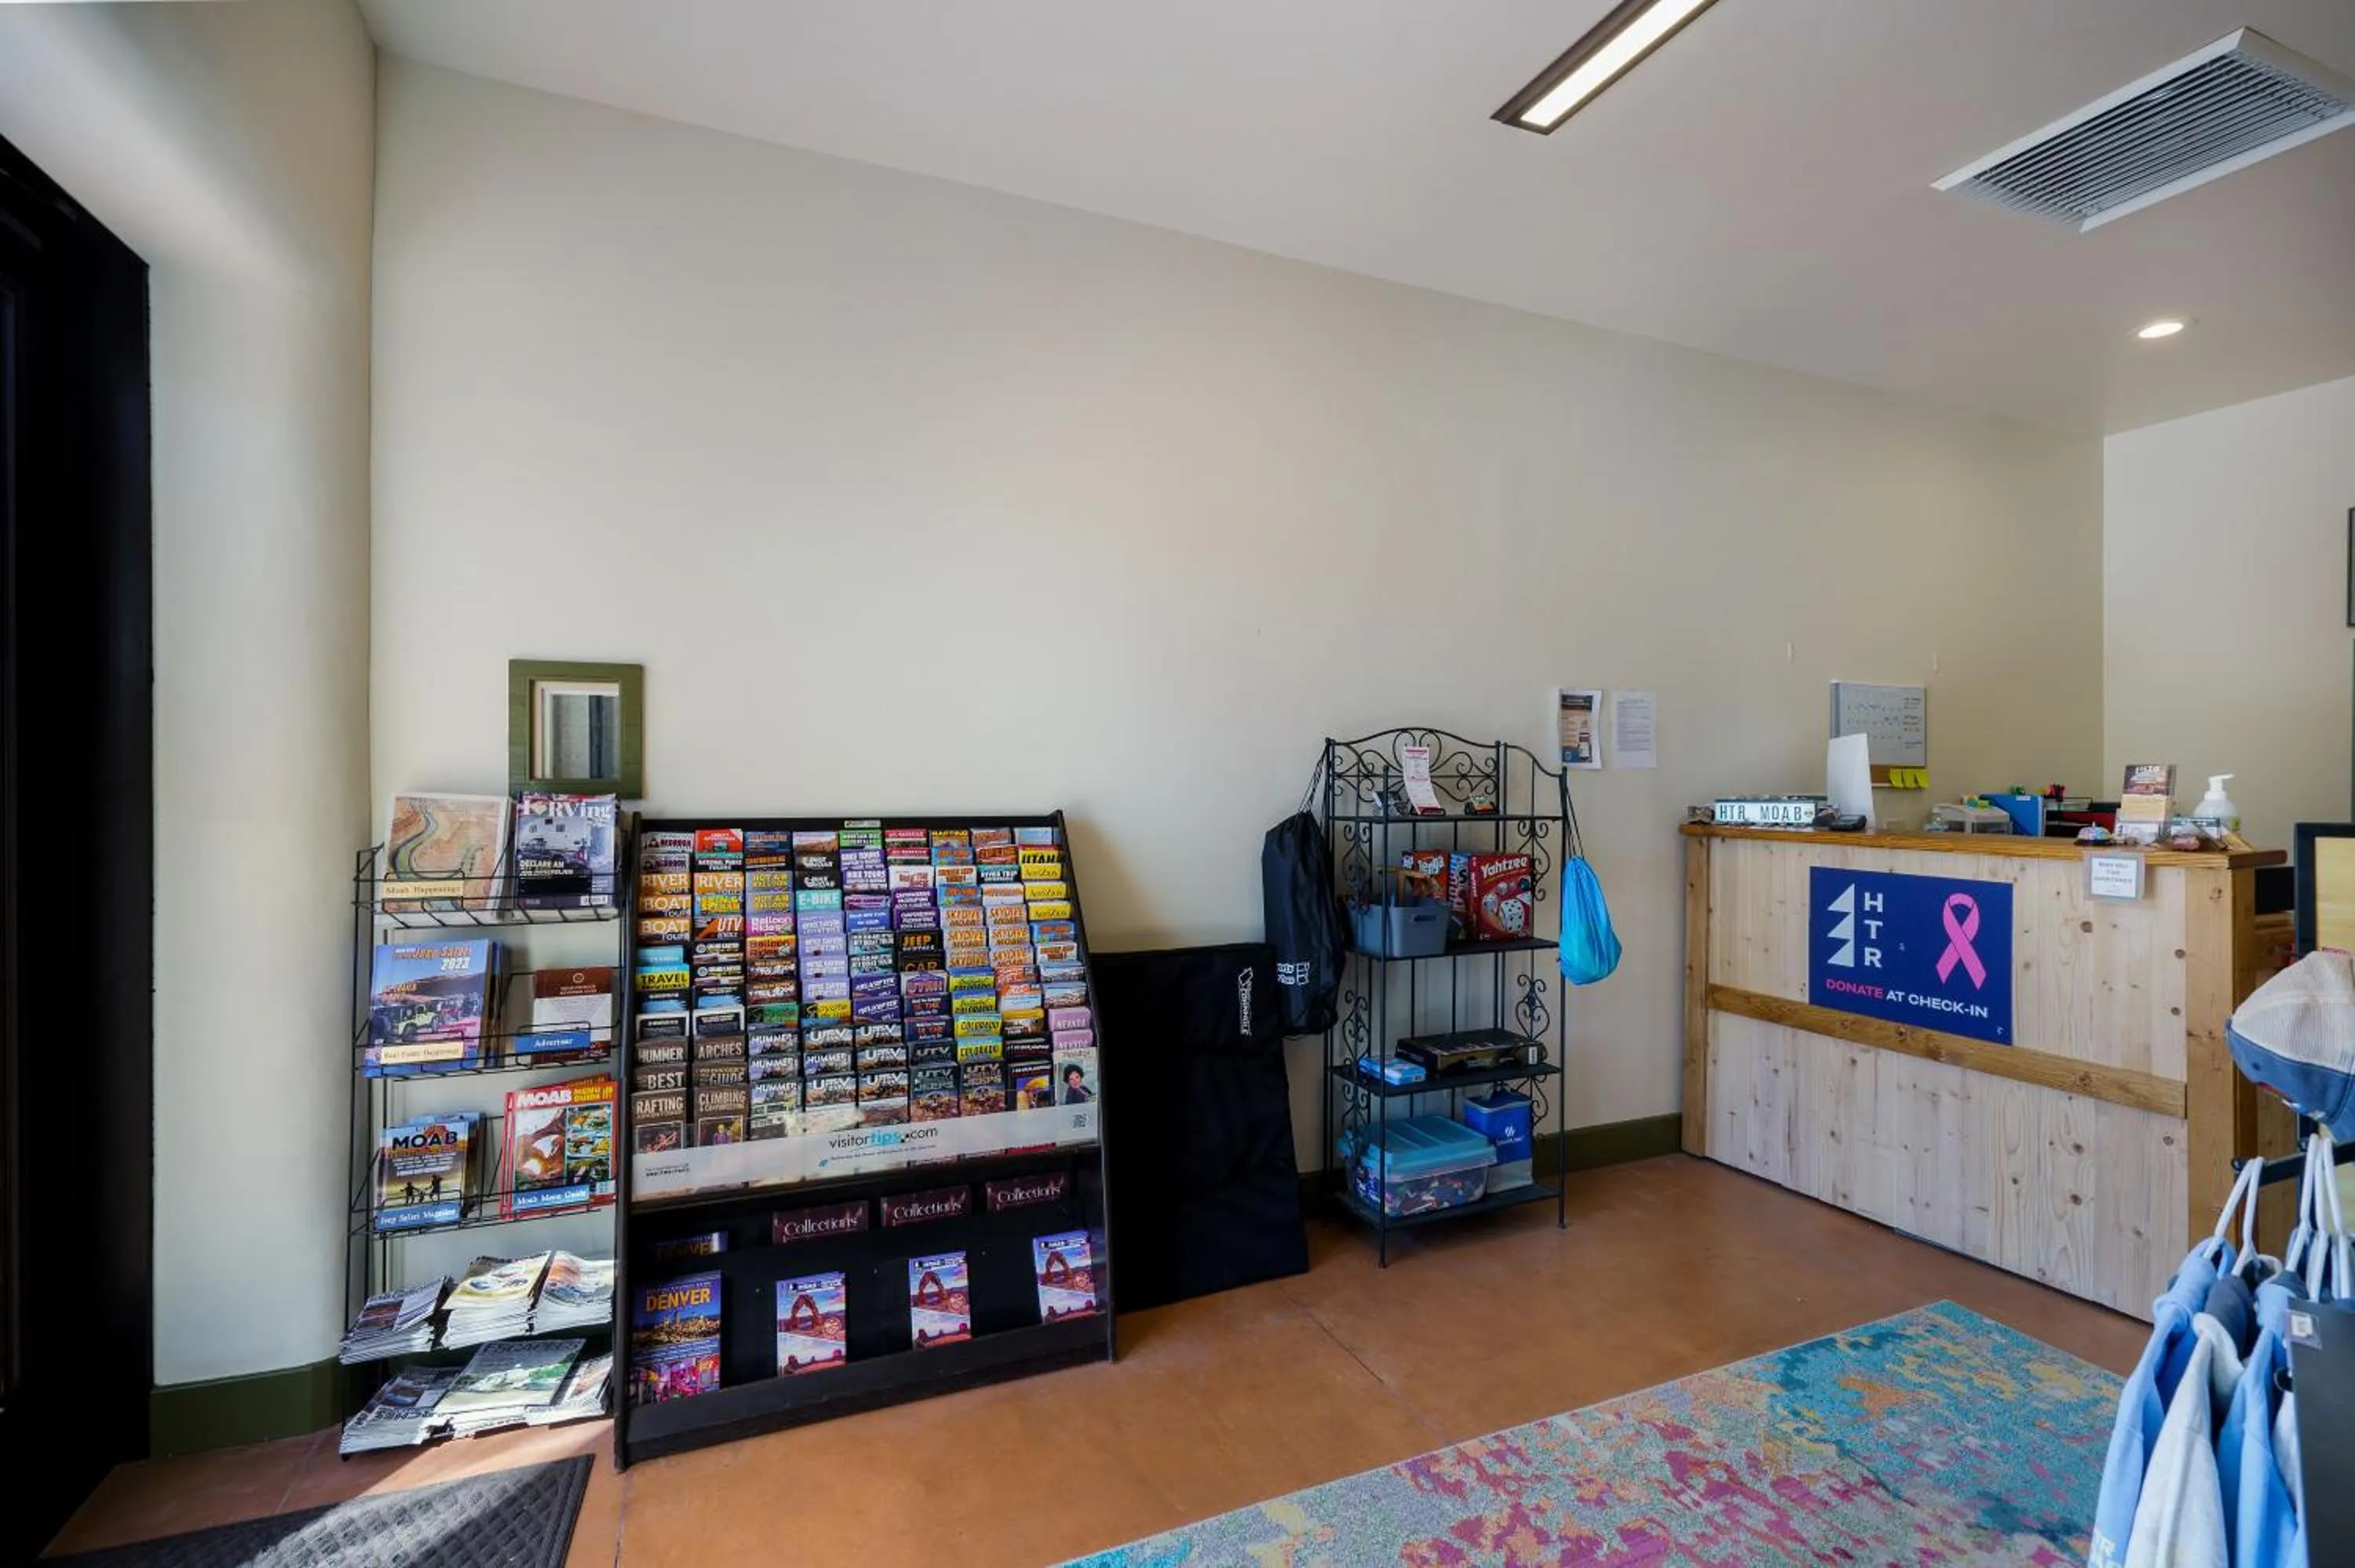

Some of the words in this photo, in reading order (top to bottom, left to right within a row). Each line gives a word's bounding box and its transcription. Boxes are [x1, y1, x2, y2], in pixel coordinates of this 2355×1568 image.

[1719, 804, 1746, 820] HTR
[1760, 805, 1802, 822] MOAB
[1481, 856, 1528, 878] Yahtzee
[641, 874, 688, 891] RIVER
[699, 876, 743, 888] RIVER
[644, 896, 689, 912] BOAT
[641, 919, 689, 935] BOAT
[717, 917, 741, 932] UTV
[1864, 892, 1883, 968] HTR
[904, 935, 933, 946] JEEP
[641, 973, 688, 983] TRAVEL
[1826, 979, 1883, 999] DONATE
[1886, 990, 1905, 1003] AT
[1908, 994, 1989, 1019] CHECK-IN
[638, 1047, 685, 1065] HUMMER
[698, 1041, 743, 1059] ARCHES
[648, 1071, 685, 1090] BEST
[709, 1072, 745, 1085] GUIDE
[517, 1088, 571, 1107] MOAB
[636, 1096, 685, 1114] RAFTING
[699, 1090, 747, 1106] CLIMBING
[392, 1131, 458, 1150] MOAB
[998, 1184, 1061, 1204] Collections
[893, 1200, 962, 1220] Collections
[784, 1216, 859, 1237] Collections
[645, 1287, 711, 1313] DENVER
